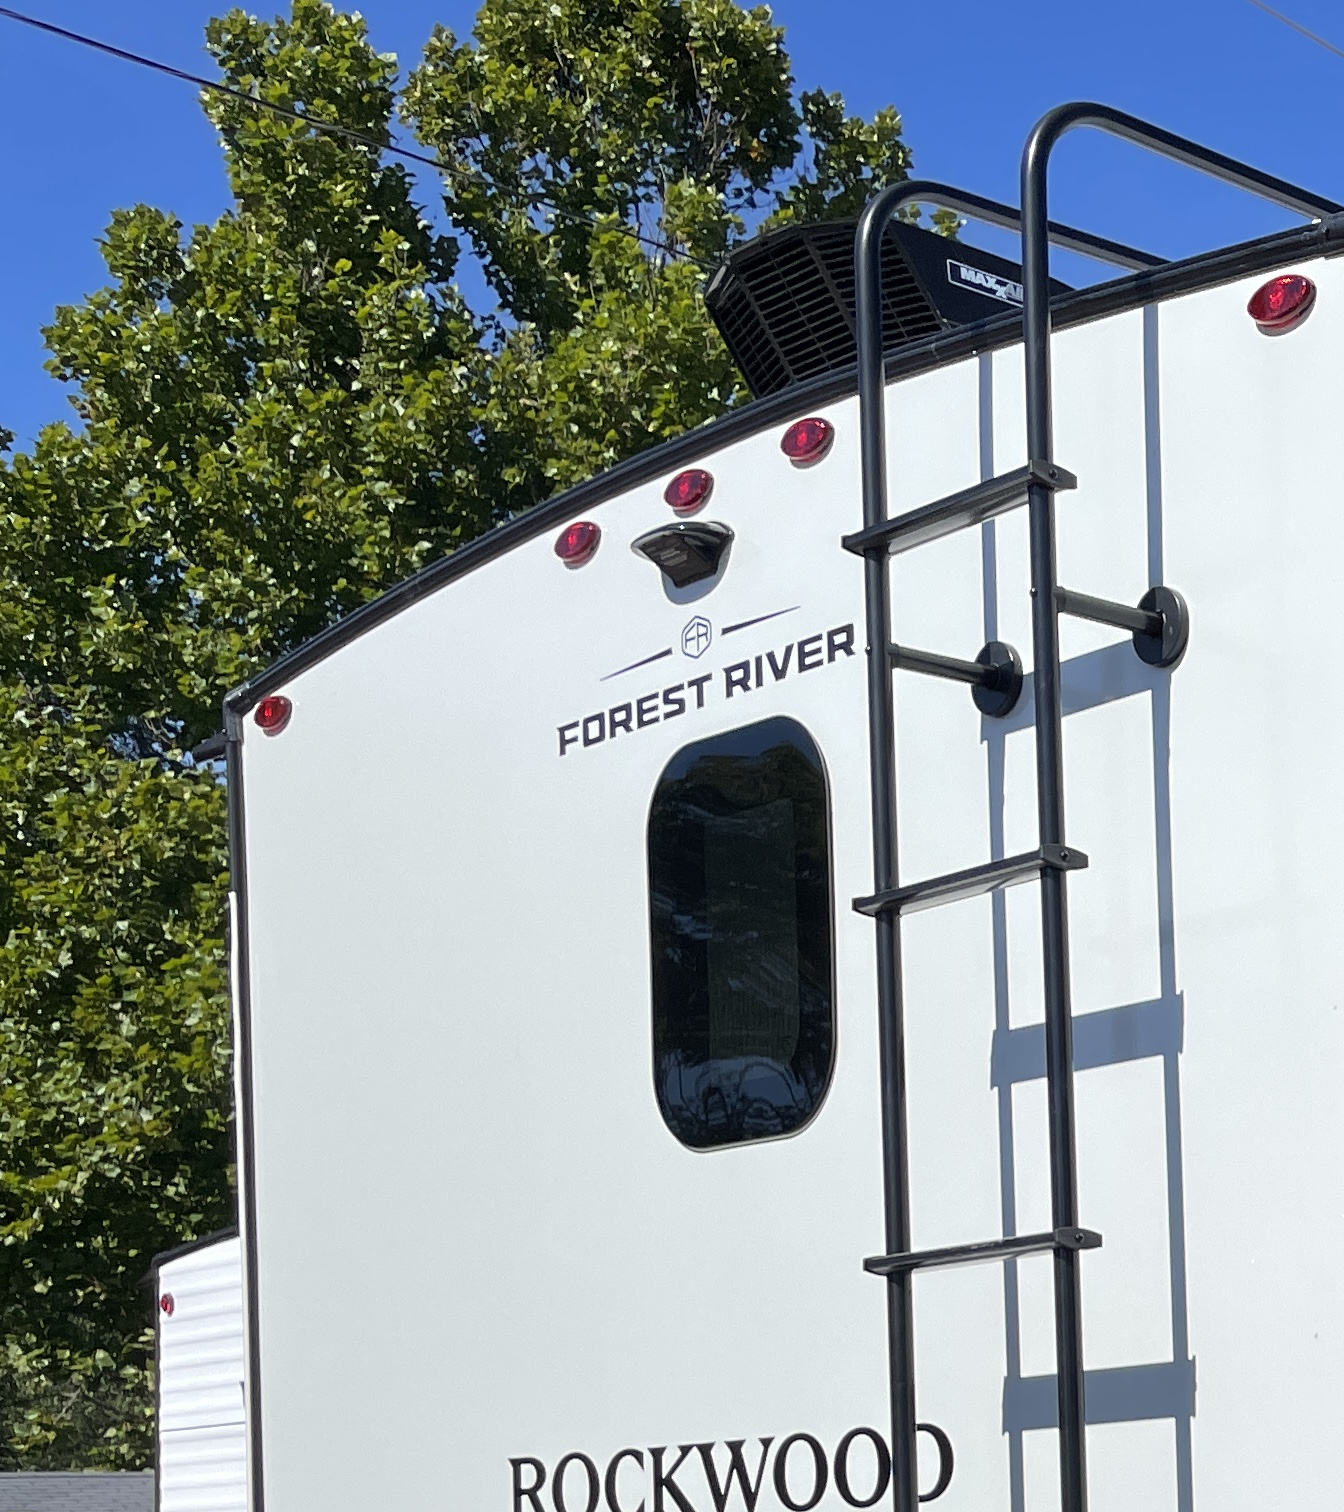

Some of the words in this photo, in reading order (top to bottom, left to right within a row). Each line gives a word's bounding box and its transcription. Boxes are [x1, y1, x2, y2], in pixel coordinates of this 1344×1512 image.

[960, 266, 1023, 302] MAXXAI
[557, 673, 713, 757] FOREST
[722, 622, 856, 699] RIVER
